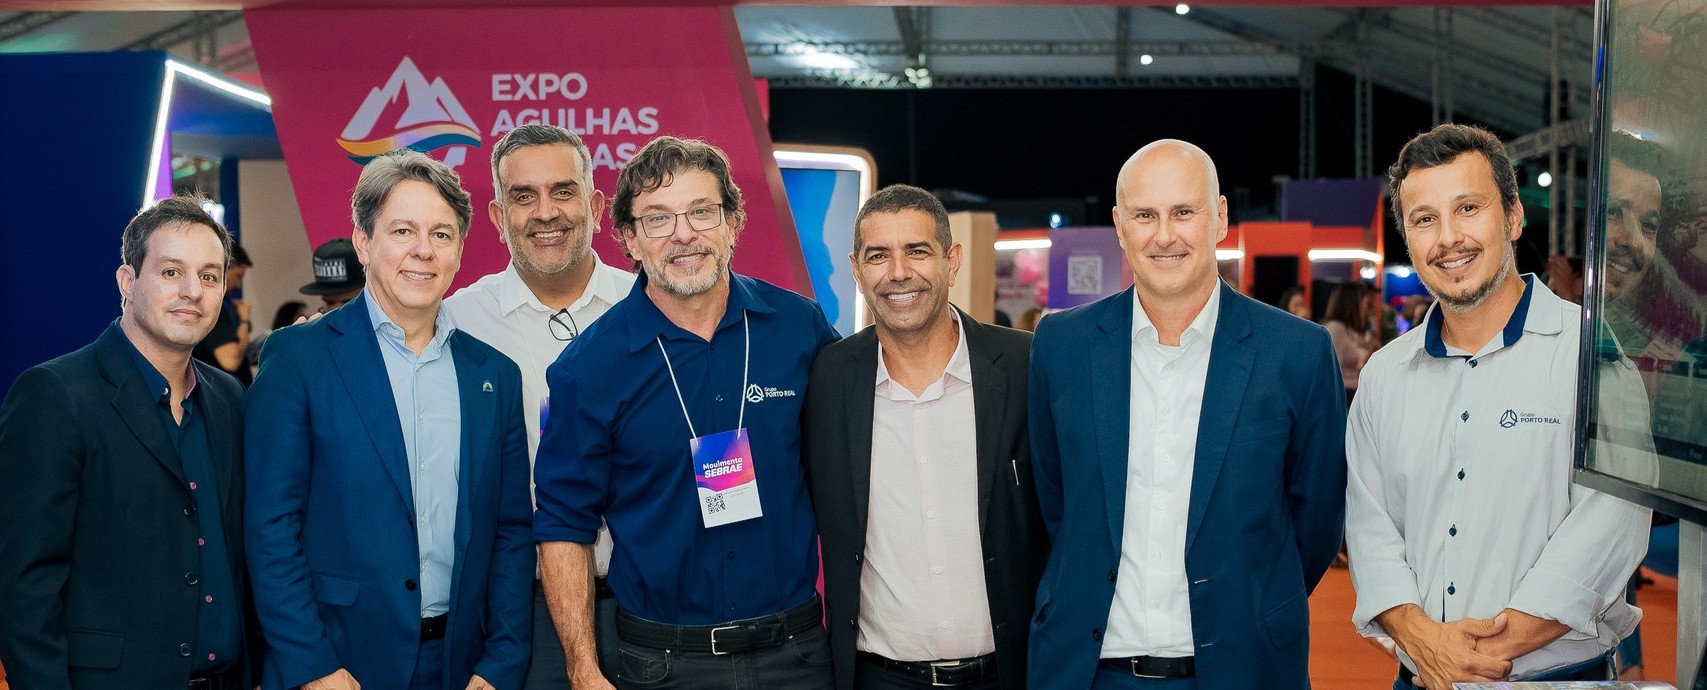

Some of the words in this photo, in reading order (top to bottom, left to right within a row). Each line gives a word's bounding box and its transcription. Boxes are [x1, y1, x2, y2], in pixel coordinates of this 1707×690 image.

[492, 72, 588, 101] EXPO
[490, 107, 659, 137] AGULHAS
[765, 390, 784, 398] PORTO
[1544, 417, 1561, 425] REAL
[704, 463, 743, 479] SEBRAE
